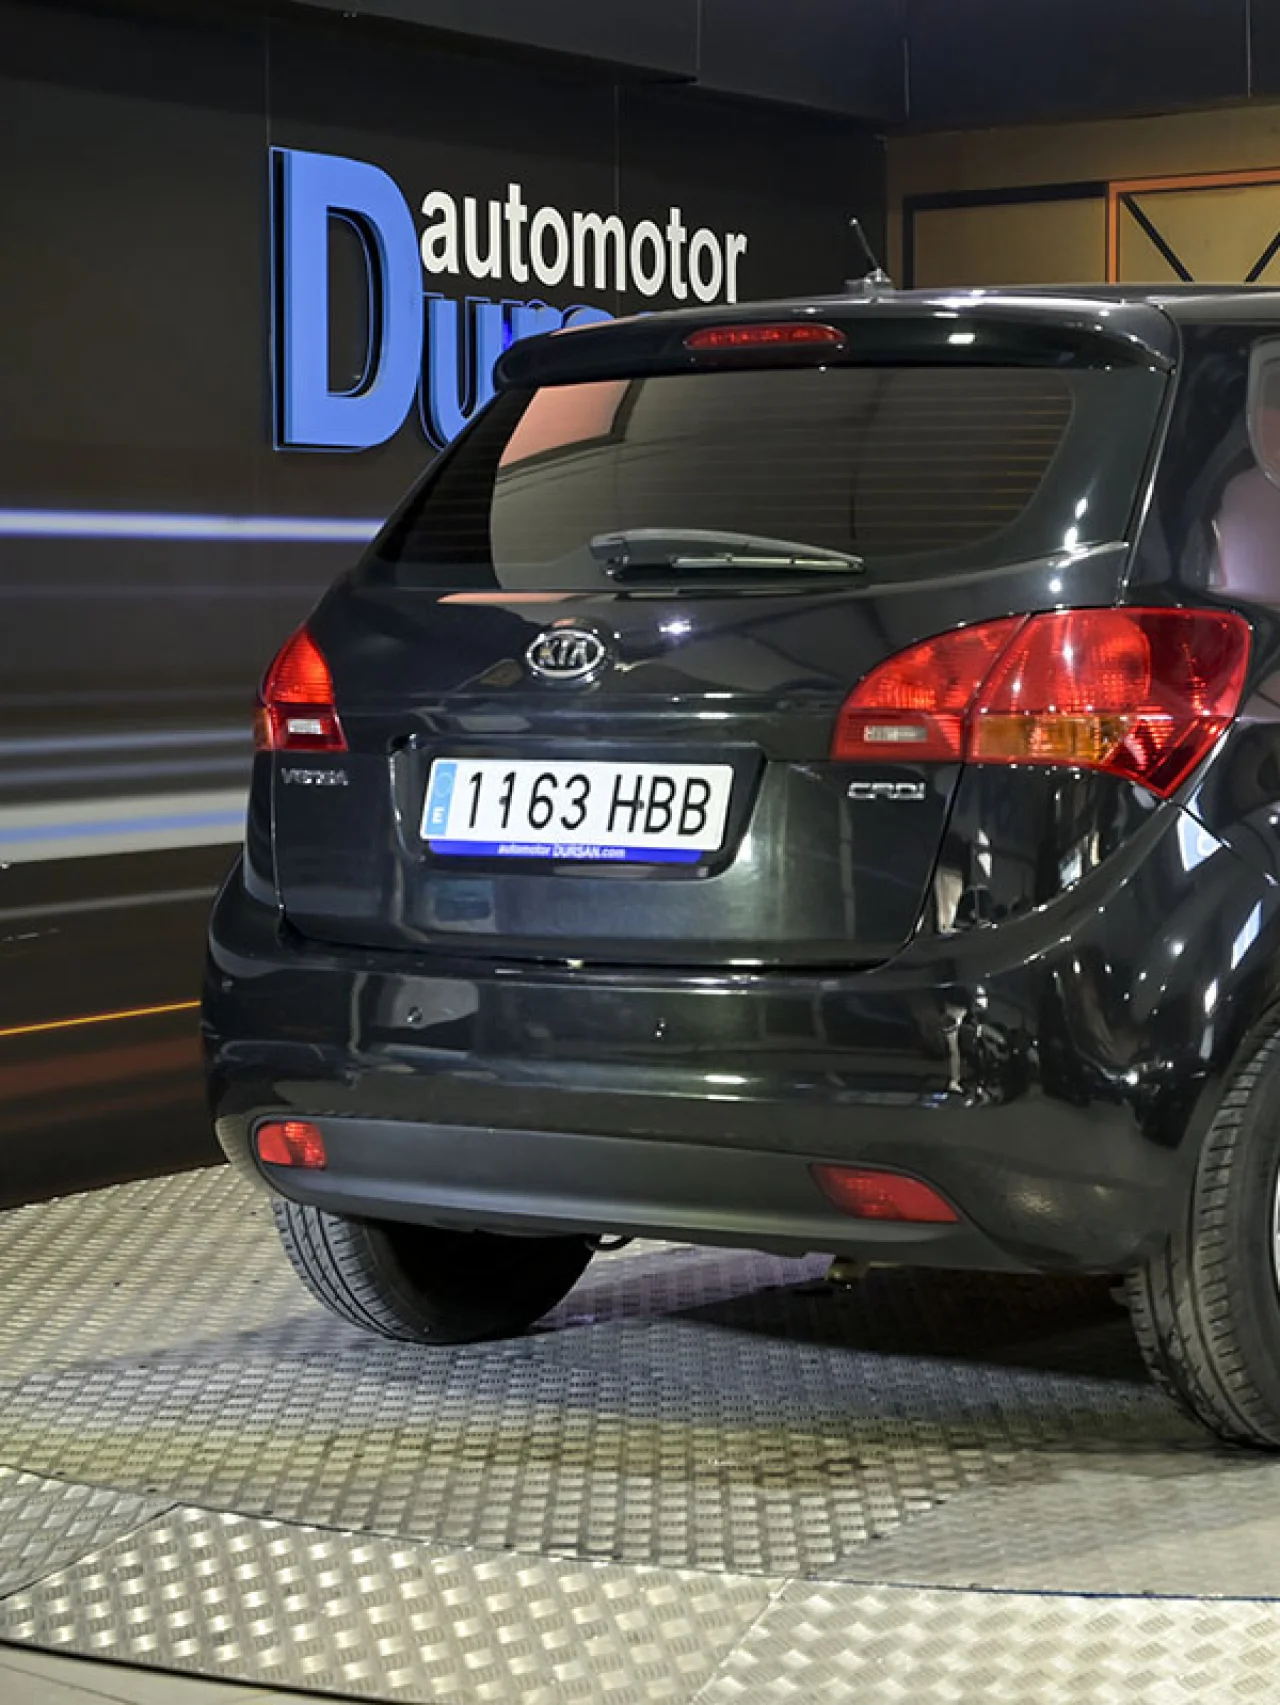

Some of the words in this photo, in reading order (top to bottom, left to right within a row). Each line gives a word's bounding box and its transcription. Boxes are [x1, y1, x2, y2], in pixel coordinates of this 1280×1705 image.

[420, 183, 748, 303] automotor
[432, 807, 444, 823] E
[468, 771, 592, 830] 1163
[606, 774, 712, 835] HBB
[498, 842, 551, 857] automotor
[552, 843, 626, 859] DURSAN.com
